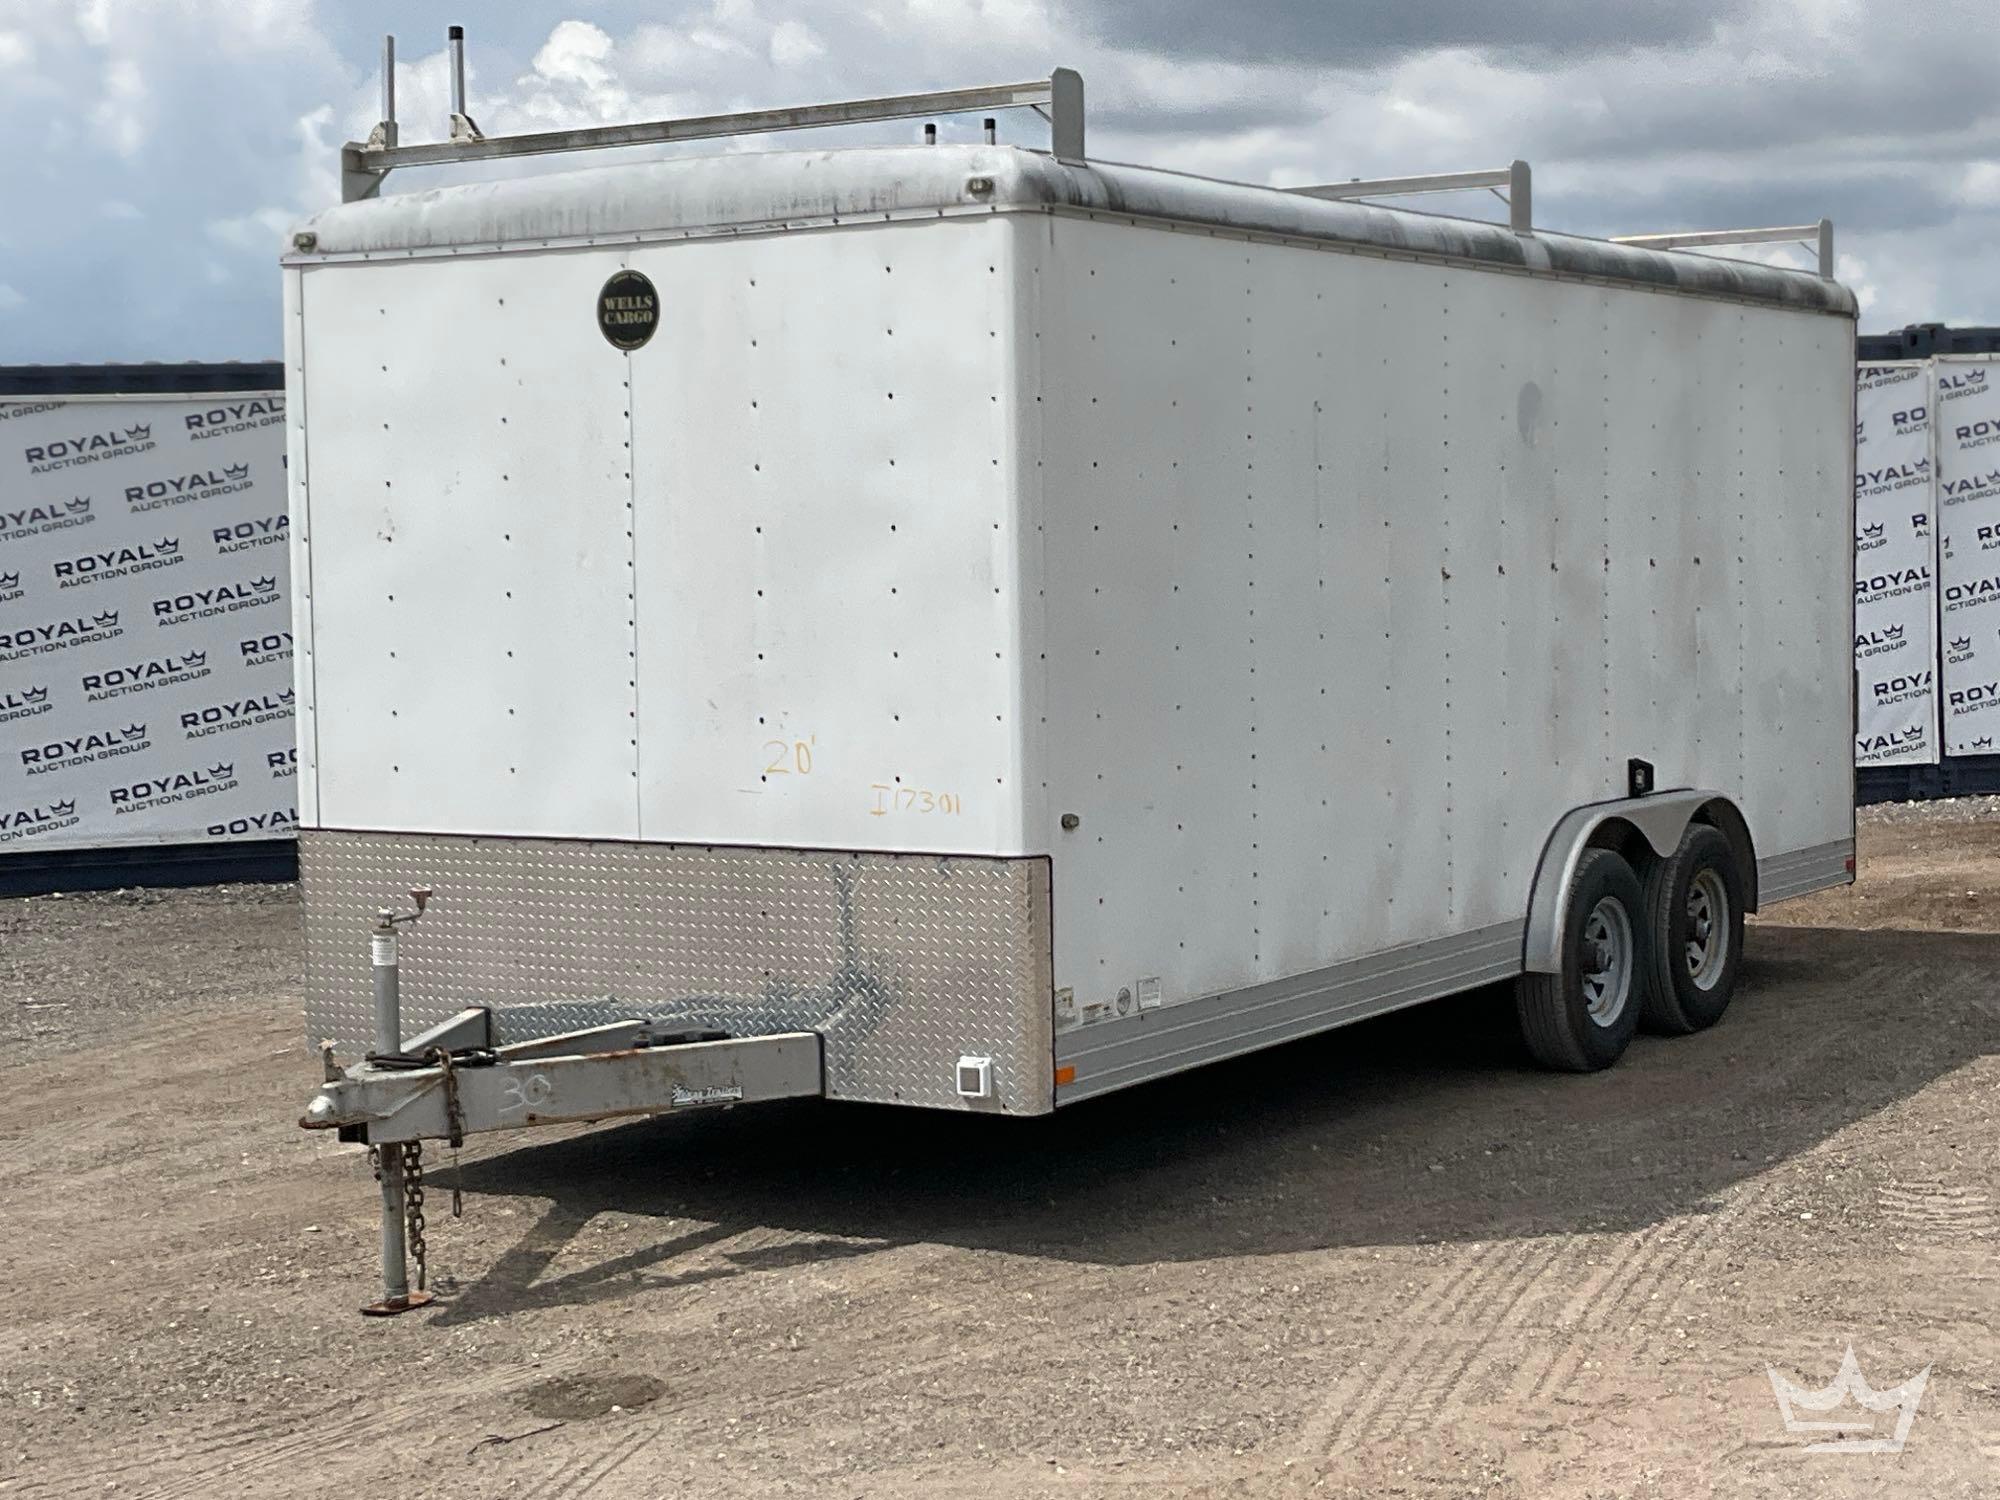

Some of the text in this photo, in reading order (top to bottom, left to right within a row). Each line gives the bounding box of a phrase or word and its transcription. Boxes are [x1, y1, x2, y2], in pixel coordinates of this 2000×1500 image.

[604, 296, 653, 310] WELLS
[604, 311, 653, 325] CARGO
[1875, 371, 1919, 387] GROUP
[1945, 385, 1989, 400] GROUP
[185, 399, 284, 430] ROYAL
[190, 420, 257, 441] AUCTION
[25, 432, 126, 463] ROYAL
[31, 441, 156, 474] AUCTION GROUP
[125, 471, 224, 502] ROYAL
[130, 481, 254, 514] AUCTION GROUP
[0, 514, 95, 542] TION GROUP
[218, 533, 285, 554] AUCTION
[54, 546, 154, 577] ROYAL
[60, 555, 184, 588] AUCTION GROUP
[152, 584, 252, 616] ROYAL
[158, 593, 281, 627] AUCTION GROUP
[1857, 586, 1911, 604] AUCTION
[0, 628, 124, 661] AUCTION GROUP
[1865, 640, 1907, 657] GROUP
[82, 659, 182, 691] ROYAL
[88, 668, 211, 702] AUCTION GROUP
[0, 703, 53, 722] GROUP
[181, 696, 279, 728] ROYAL
[1877, 688, 1931, 706] AUCTION
[1953, 698, 2000, 715] AUCTIO
[186, 718, 252, 740] AUCTION
[21, 731, 122, 765] ROYAL
[26, 741, 151, 776] AUCTION GROUP
[1883, 741, 1926, 758] GROUP
[110, 771, 209, 804] ROYAL
[115, 780, 239, 815] AUCTION GROUP
[26, 817, 80, 836] GROUP
